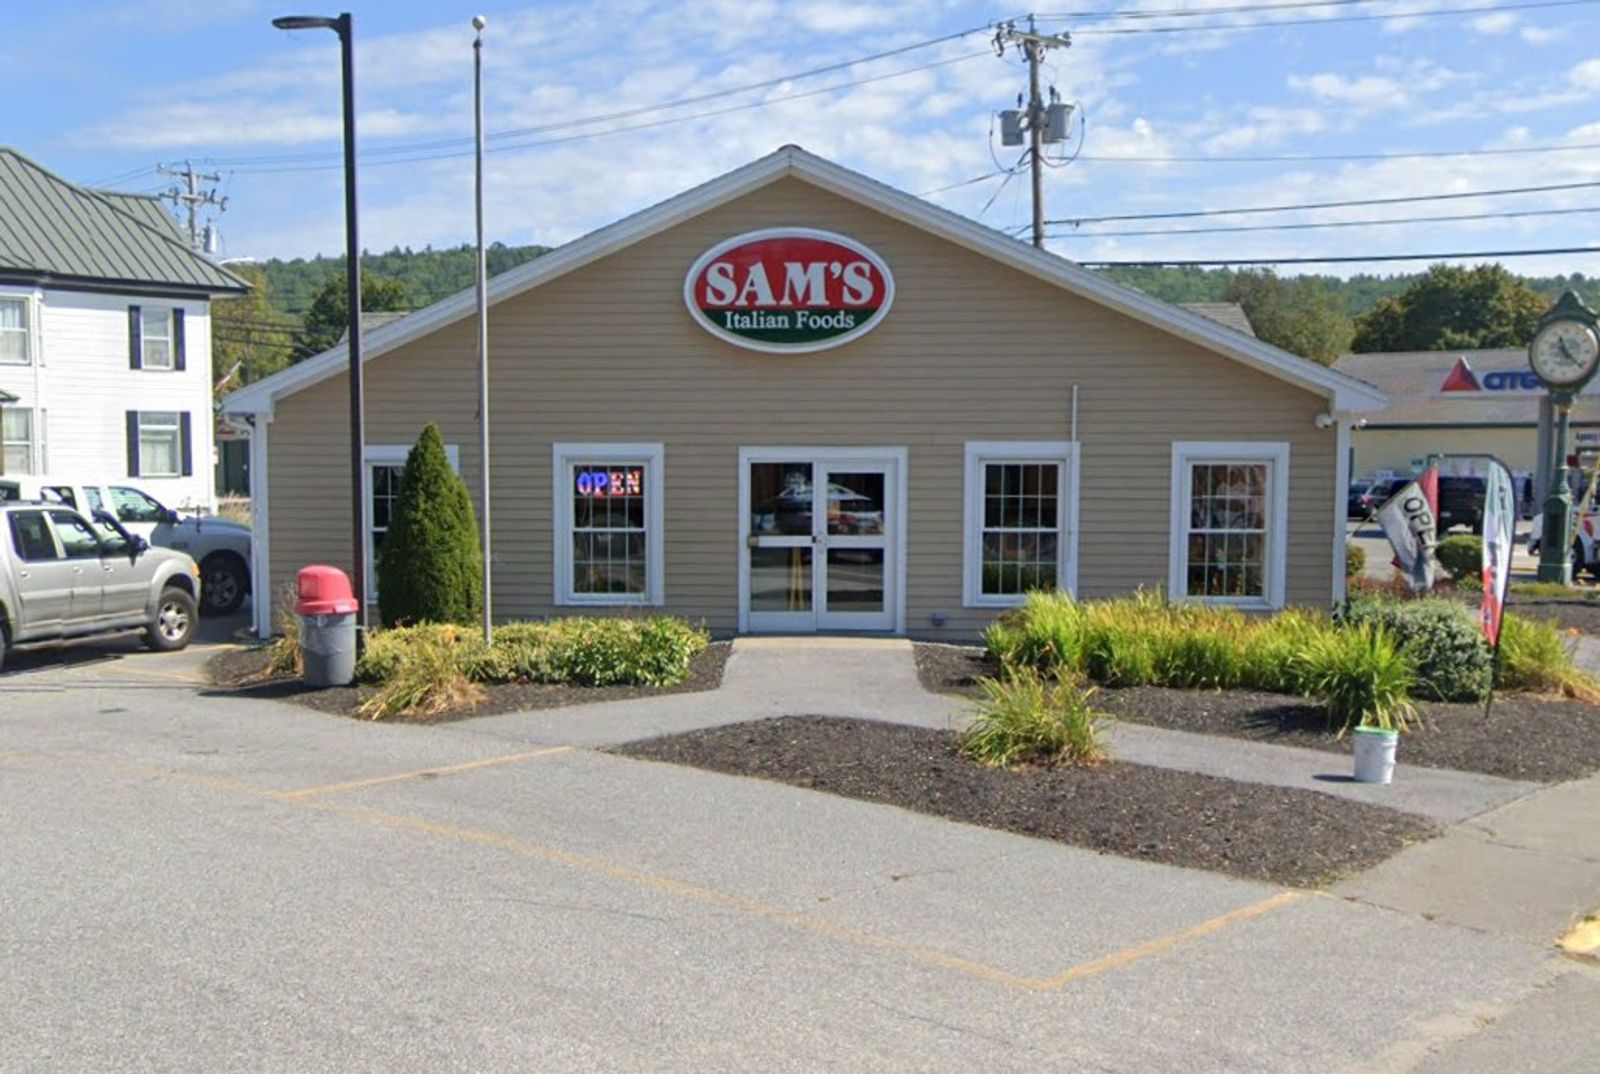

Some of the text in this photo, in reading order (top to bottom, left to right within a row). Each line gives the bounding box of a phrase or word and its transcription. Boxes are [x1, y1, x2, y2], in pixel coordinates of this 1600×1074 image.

[706, 261, 874, 305] SAM'S
[725, 310, 855, 329] Italian Foods
[1483, 371, 1546, 391] CITG
[577, 471, 641, 497] OPEN
